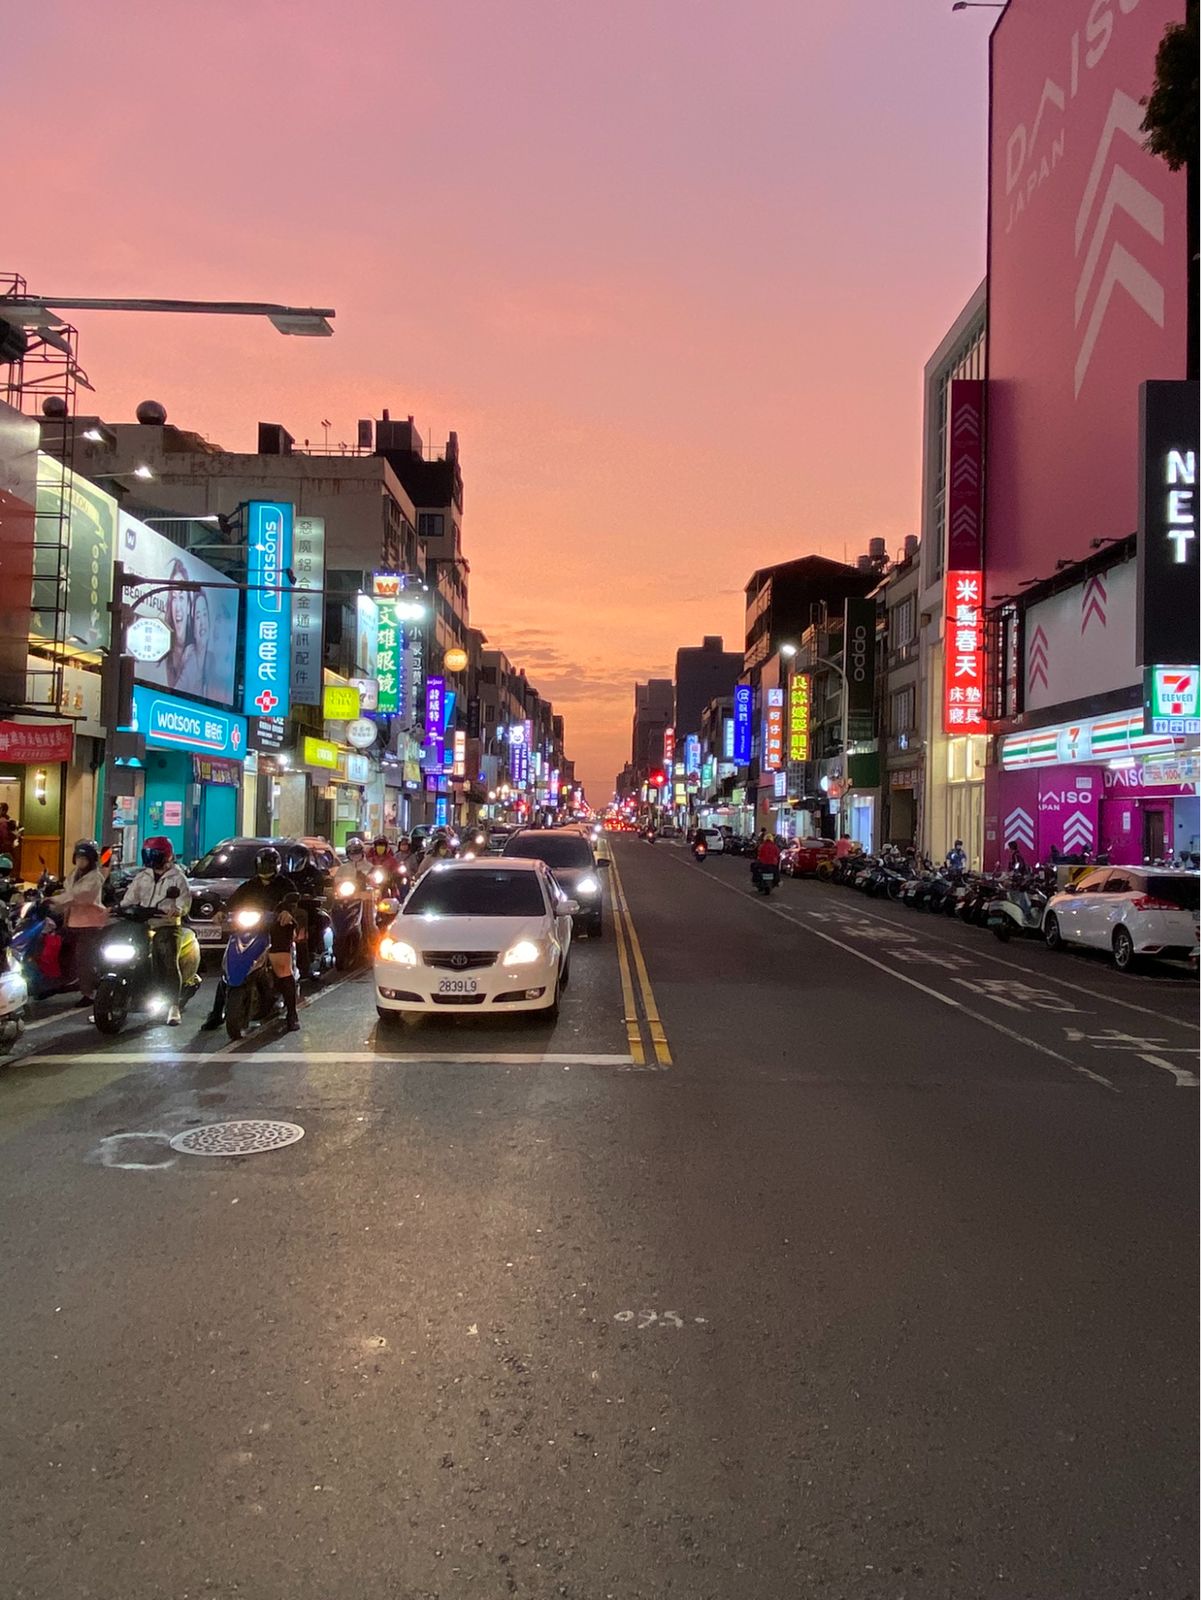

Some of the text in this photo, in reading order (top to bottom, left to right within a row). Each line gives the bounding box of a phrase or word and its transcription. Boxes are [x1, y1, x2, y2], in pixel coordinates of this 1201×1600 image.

[1005, 128, 1065, 234] JAPAN
[1167, 449, 1195, 564] NET
[263, 520, 277, 599] watsons
[258, 621, 278, 681] 屈臣氏
[377, 606, 398, 695] 文雄眼鏡
[853, 625, 867, 682] oppo
[157, 710, 200, 733] watsons
[1162, 674, 1192, 715] 7
